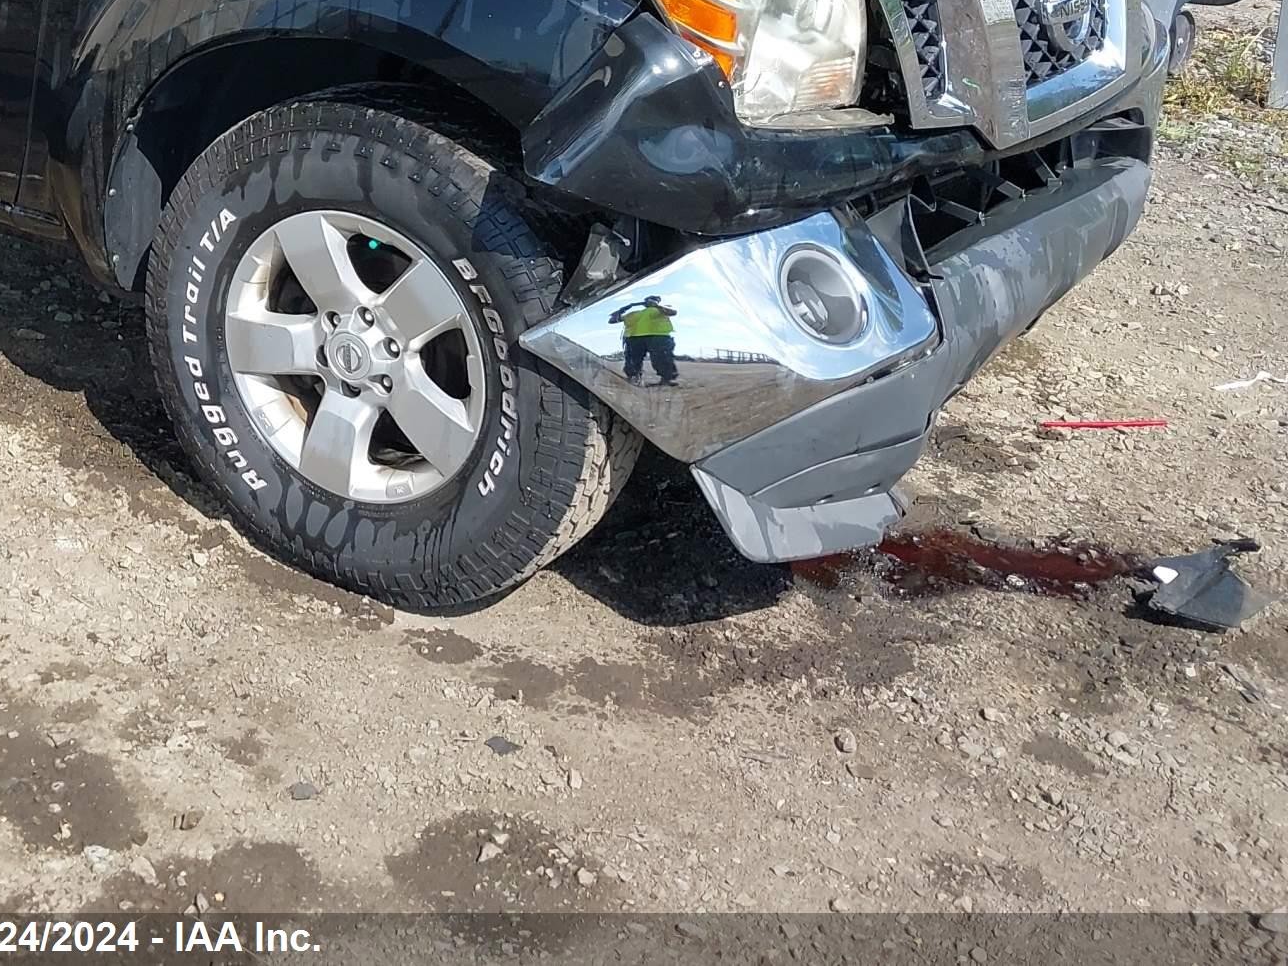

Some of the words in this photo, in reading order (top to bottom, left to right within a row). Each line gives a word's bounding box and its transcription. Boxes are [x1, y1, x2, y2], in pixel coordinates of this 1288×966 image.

[199, 208, 237, 252] T/A
[182, 255, 206, 343] Trail
[183, 355, 269, 492] Rugged
[451, 257, 518, 497] BFGoodrich
